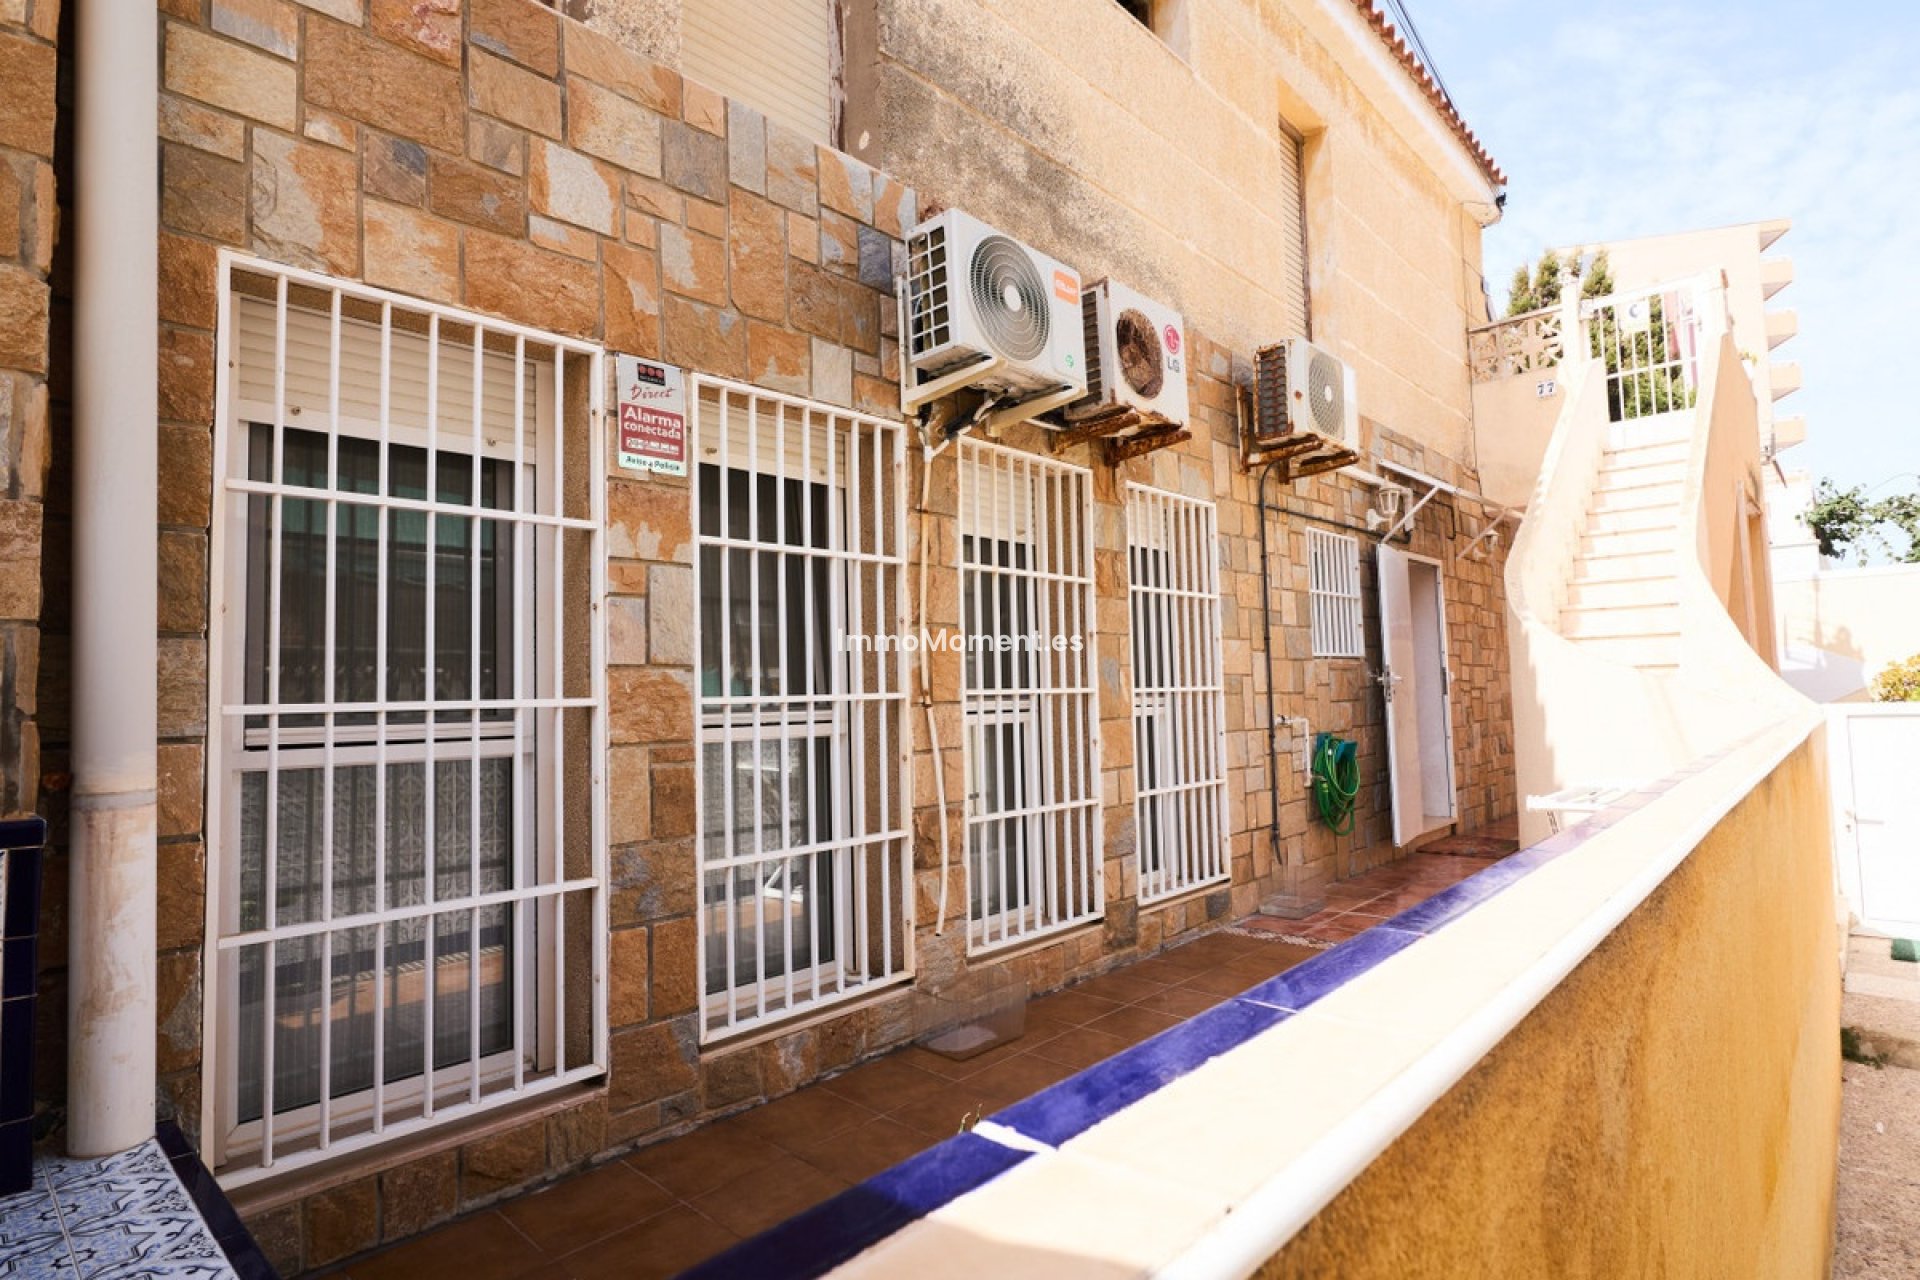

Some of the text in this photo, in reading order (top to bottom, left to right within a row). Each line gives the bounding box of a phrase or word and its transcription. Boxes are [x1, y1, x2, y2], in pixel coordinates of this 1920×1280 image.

[1167, 357, 1180, 373] LG
[624, 406, 680, 429] Alarma
[624, 421, 680, 440] conectada
